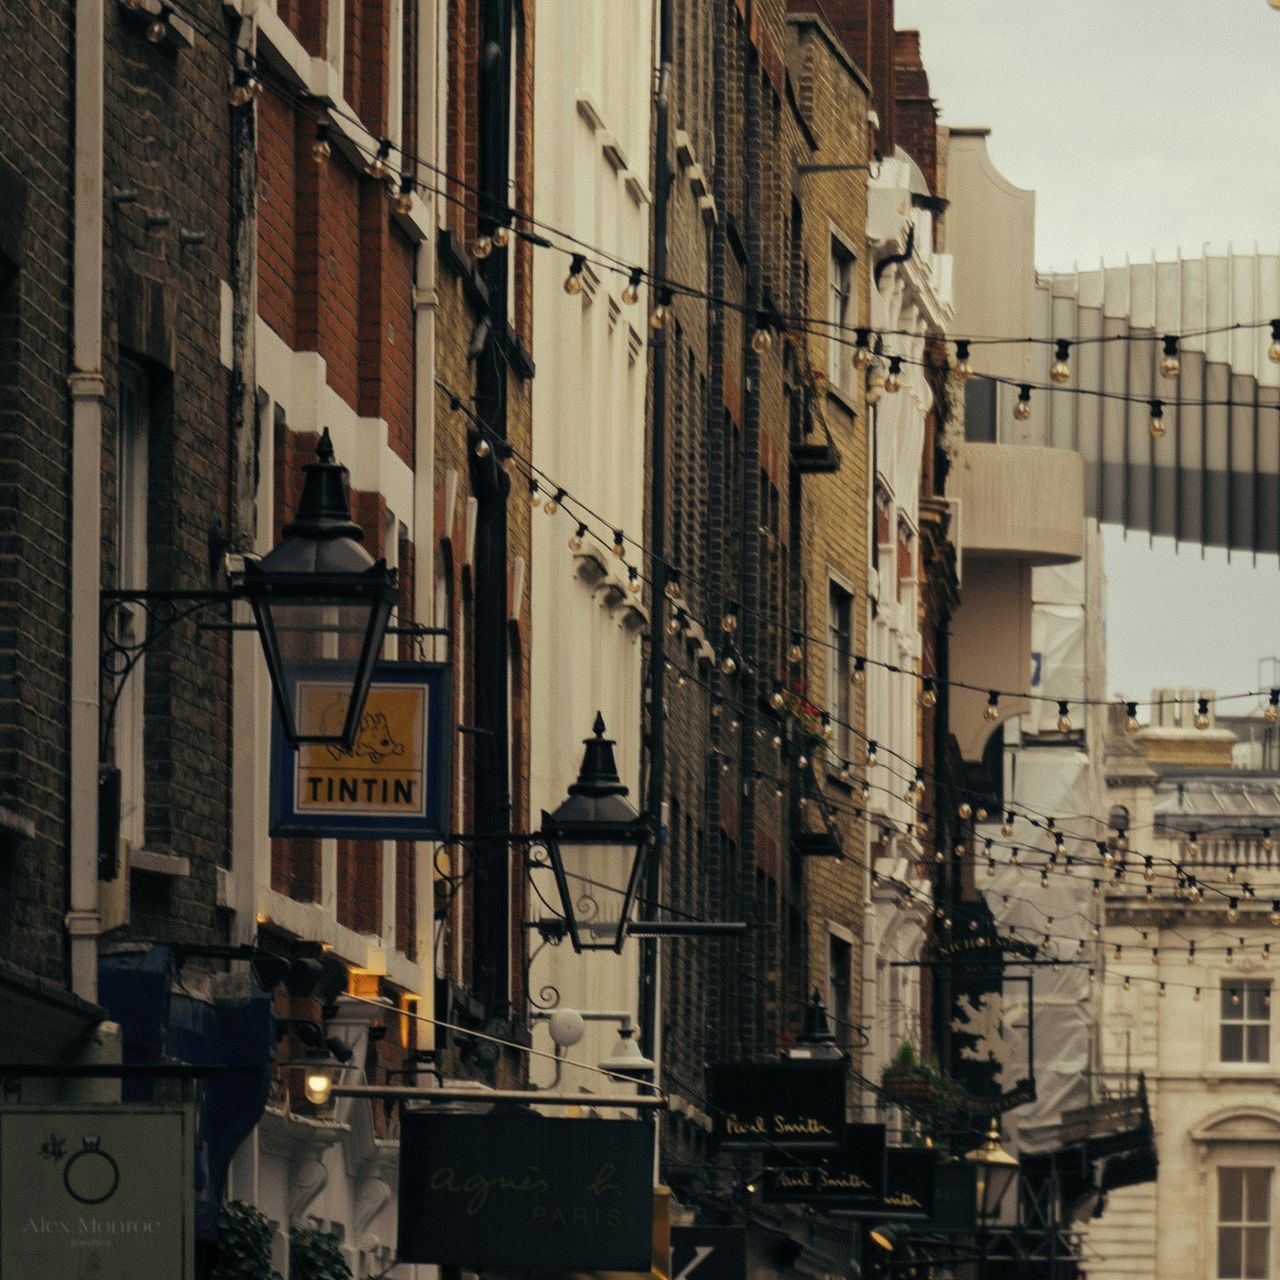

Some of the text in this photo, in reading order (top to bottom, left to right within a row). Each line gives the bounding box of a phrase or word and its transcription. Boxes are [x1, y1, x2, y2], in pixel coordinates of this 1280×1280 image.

[307, 776, 413, 804] TINTIN
[725, 1113, 833, 1135] Paul Smith
[23, 1216, 162, 1233] Alex Monroe
[530, 1207, 622, 1225] PARIS
